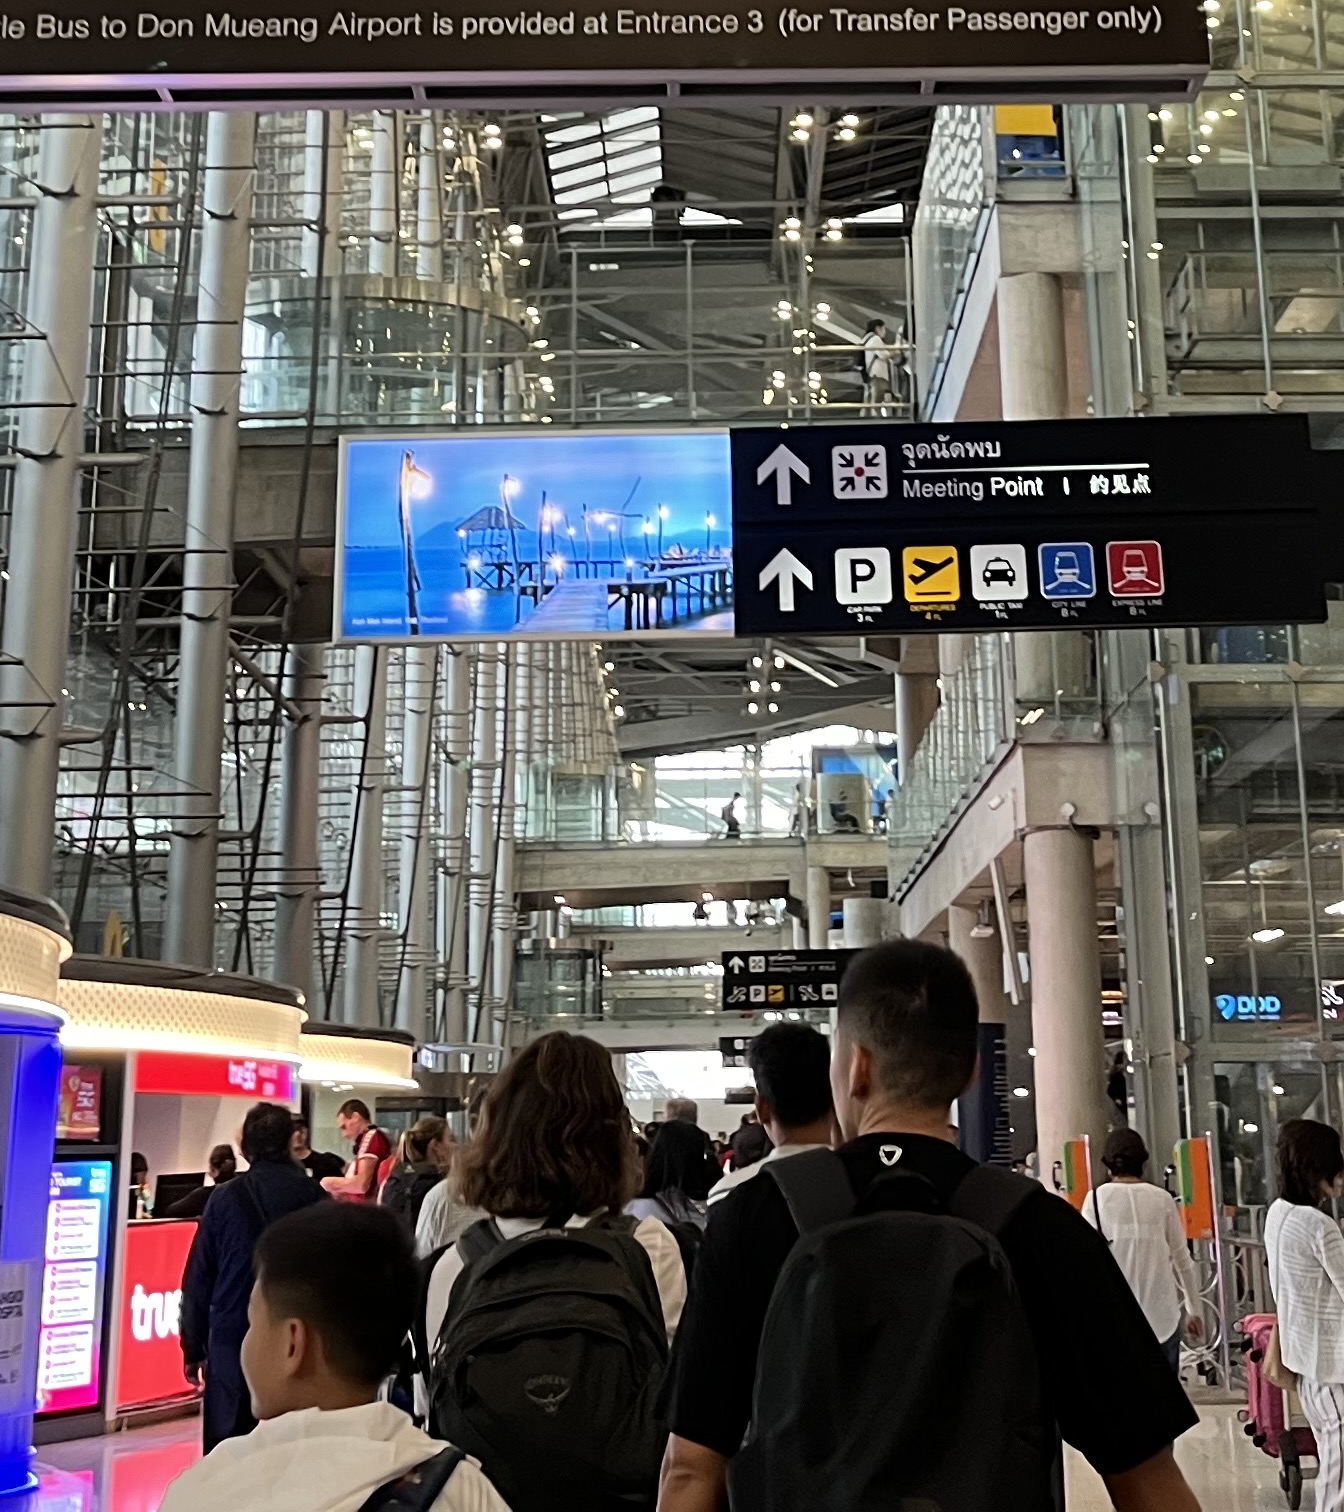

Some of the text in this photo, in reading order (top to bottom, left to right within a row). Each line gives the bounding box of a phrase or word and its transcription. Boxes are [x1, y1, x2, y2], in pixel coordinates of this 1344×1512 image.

[35, 13, 90, 40] Bus
[100, 14, 127, 39] to
[137, 13, 194, 39] Don
[205, 12, 318, 43] Mueang
[328, 11, 422, 42] Airport
[432, 11, 453, 36] is
[461, 10, 575, 40] provided
[582, 11, 609, 36] at
[616, 9, 739, 35] Entrance
[746, 9, 765, 35] 3
[778, 8, 823, 39] (for
[829, 7, 940, 34] Transfer
[947, 6, 1089, 36] Passenger
[1096, 5, 1162, 36] only)
[901, 433, 1001, 469] จุดนัดพบ
[902, 476, 1044, 502] Meeting Point
[850, 558, 876, 593] P
